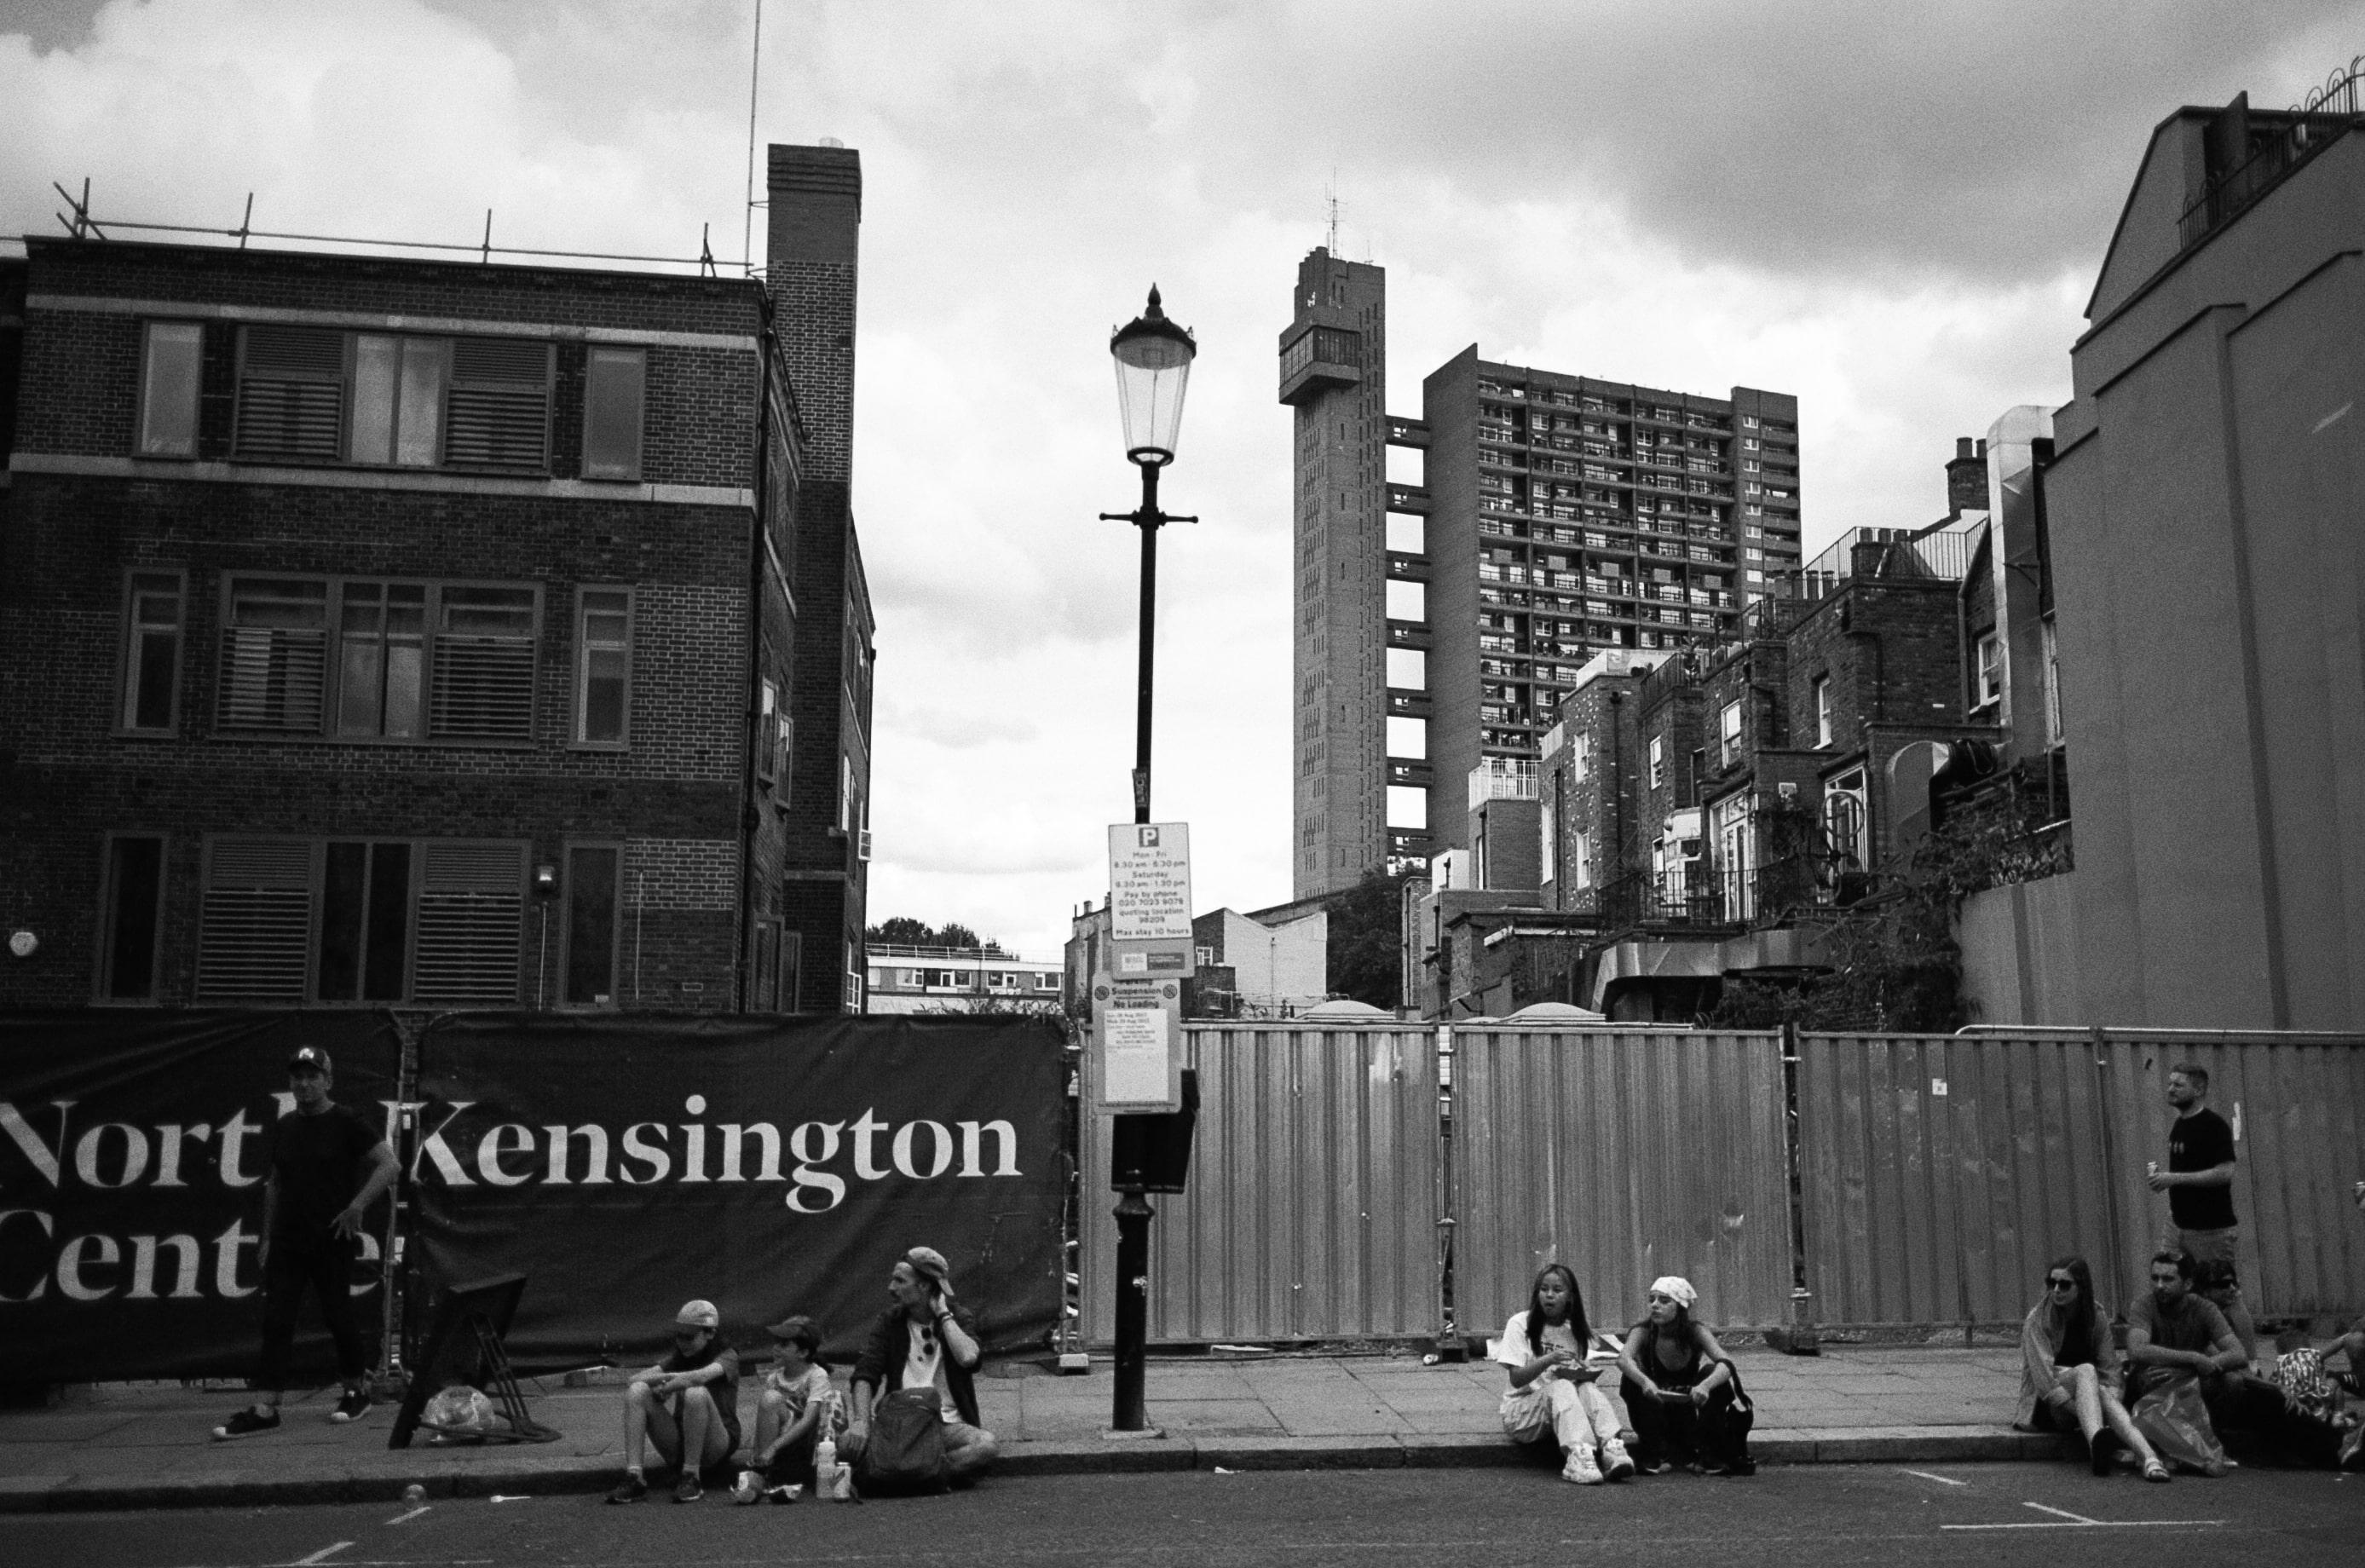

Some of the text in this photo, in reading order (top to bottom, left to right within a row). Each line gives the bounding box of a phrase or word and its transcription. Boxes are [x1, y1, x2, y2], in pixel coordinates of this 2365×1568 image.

[1142, 828, 1157, 847] P
[1135, 927, 1152, 937] stay
[1111, 987, 1162, 995] Suspension
[1128, 1000, 1160, 1009] Loading
[0, 1092, 1023, 1213] Nort Kensington
